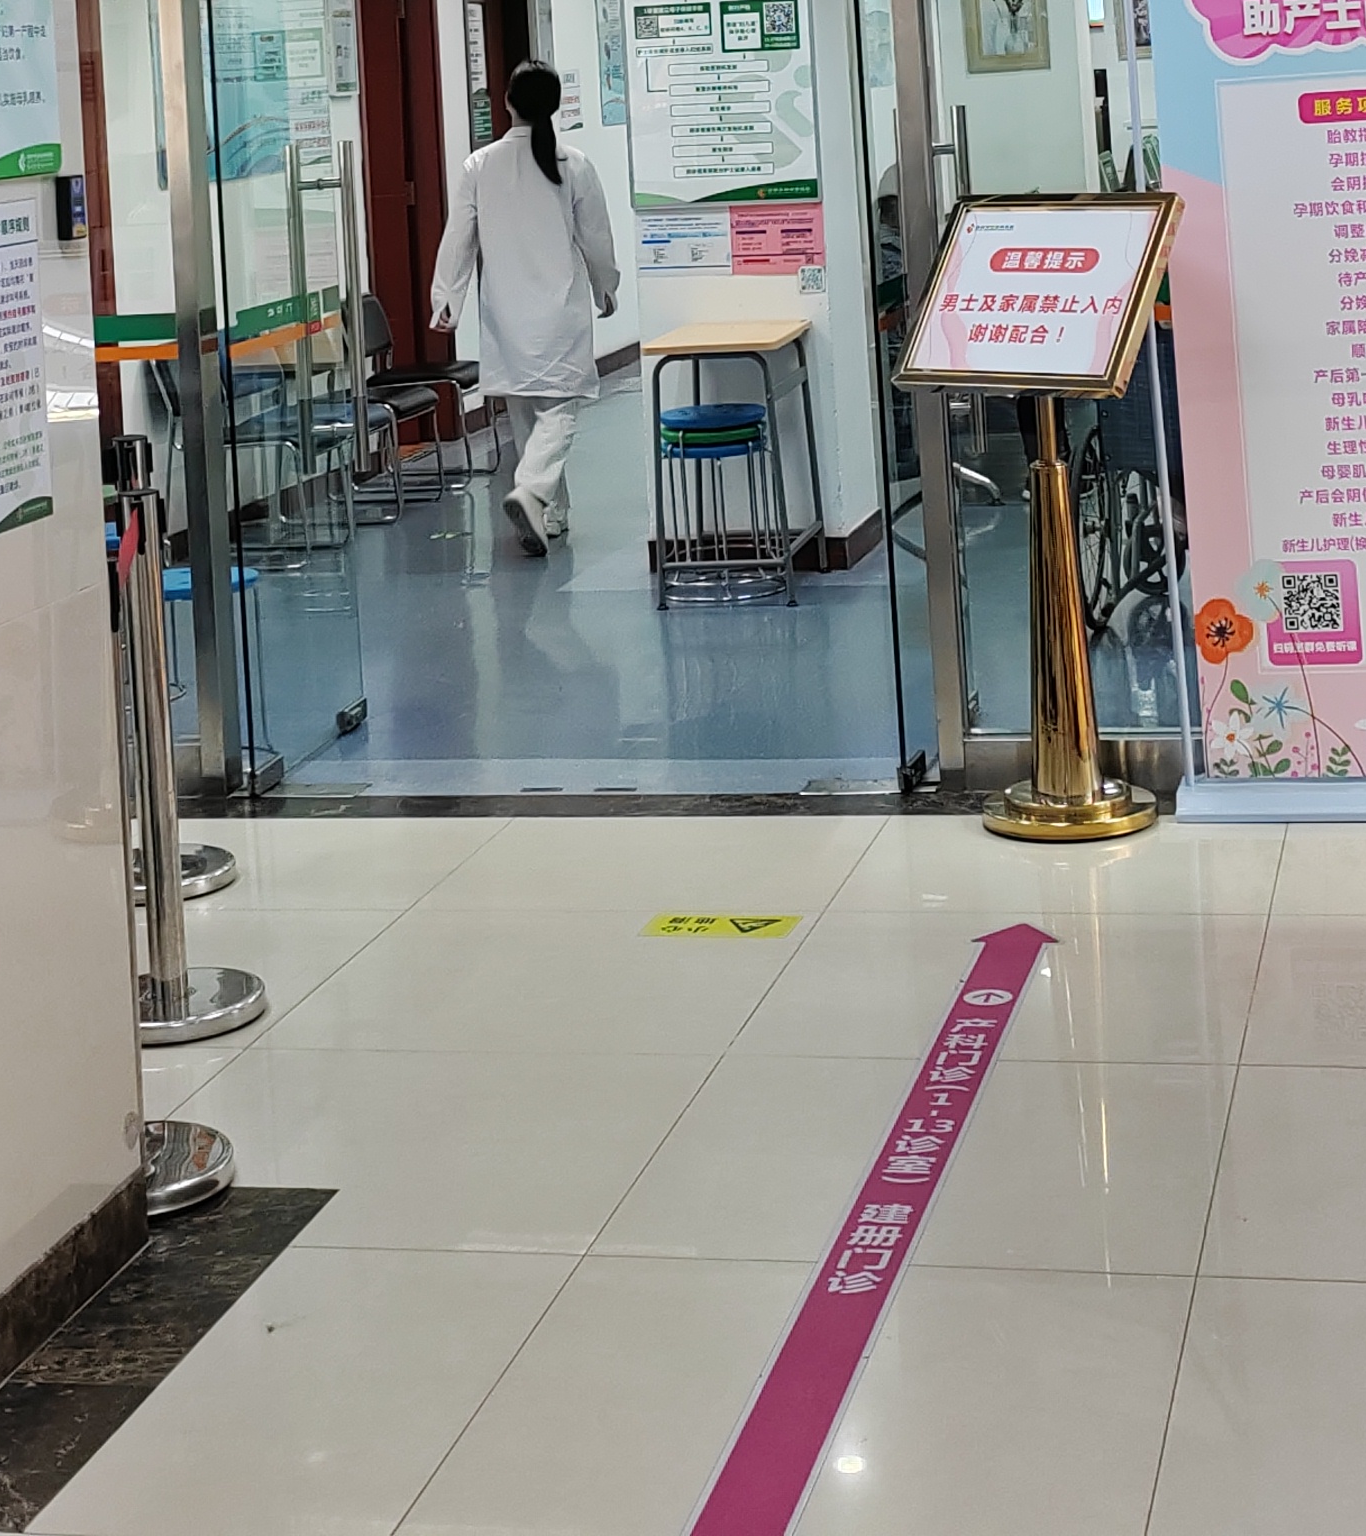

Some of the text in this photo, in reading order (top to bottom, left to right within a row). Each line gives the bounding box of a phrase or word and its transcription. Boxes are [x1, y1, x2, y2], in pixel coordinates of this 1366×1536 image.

[1001, 251, 1086, 269] 温馨提示
[938, 293, 1123, 316] 男士及家属禁止入内
[967, 322, 1065, 344] 谢谢配合！
[827, 1202, 915, 1295] 建册门诊
